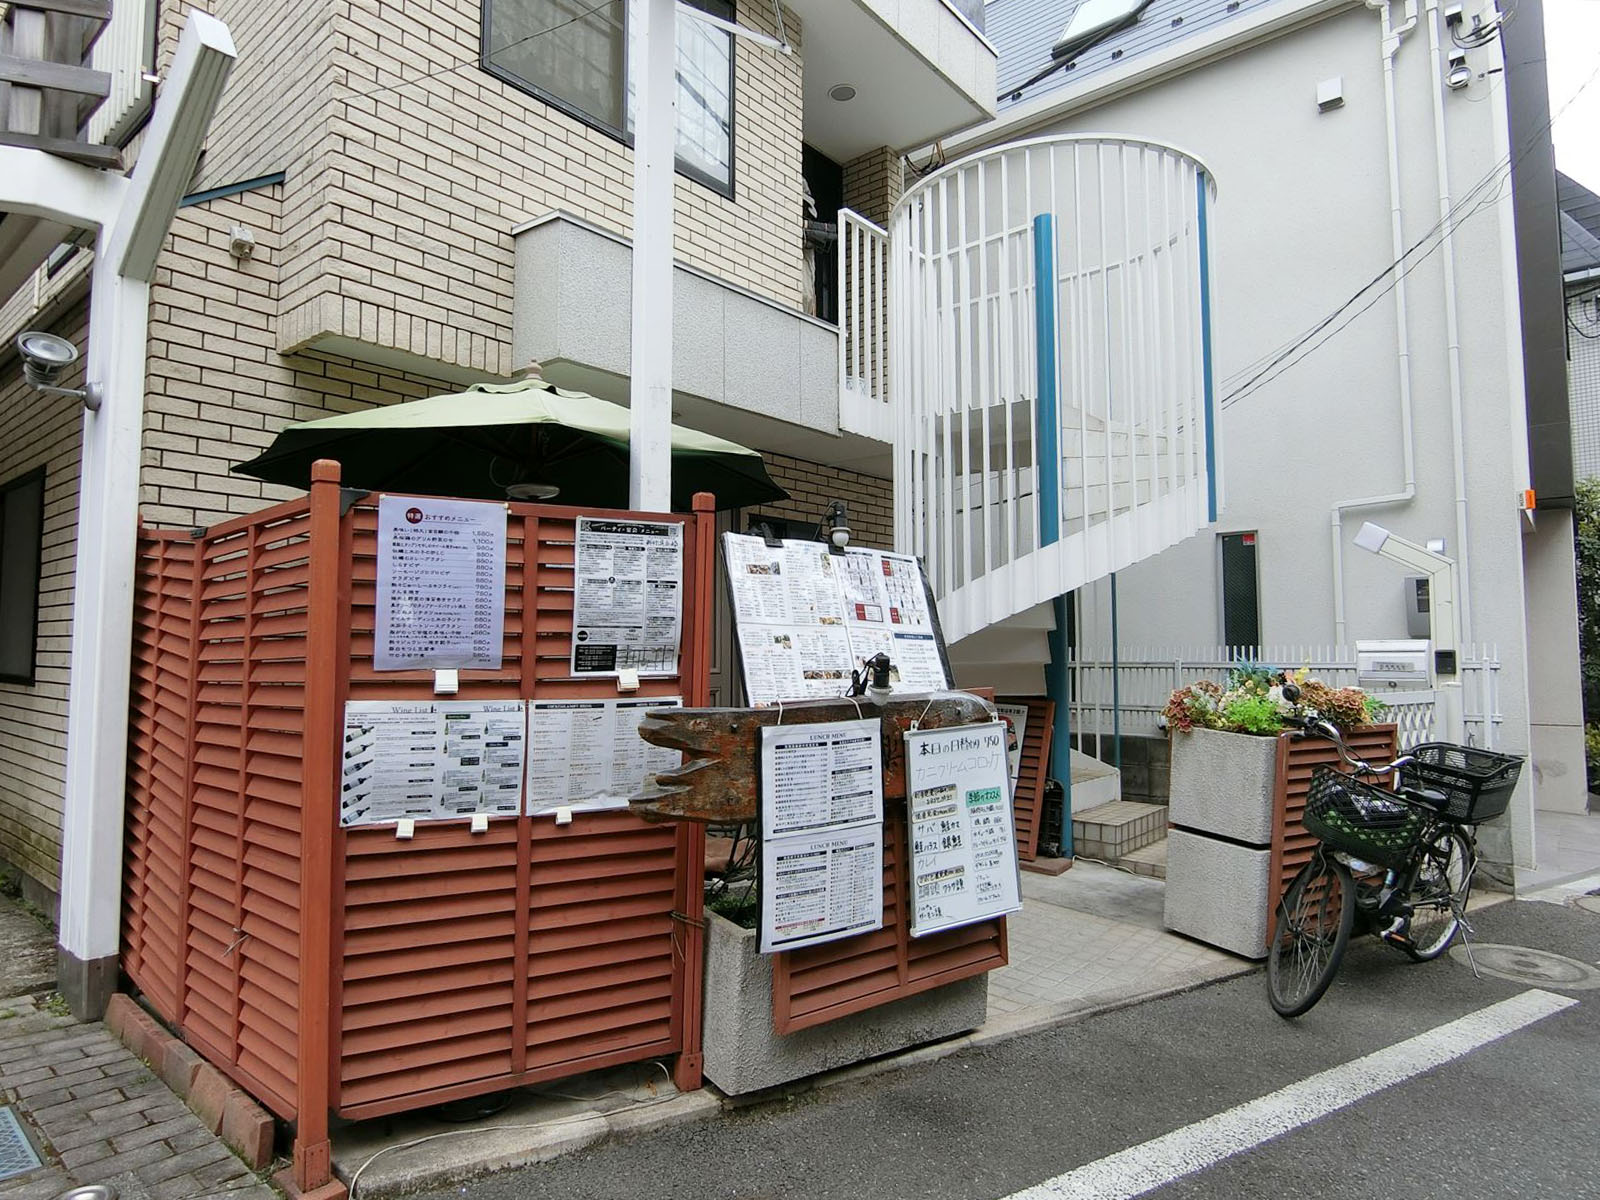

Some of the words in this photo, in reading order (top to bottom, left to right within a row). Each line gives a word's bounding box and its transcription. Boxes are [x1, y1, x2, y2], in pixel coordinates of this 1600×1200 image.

[424, 513, 475, 523] おすすめメニュー
[918, 822, 935, 834] サバ
[914, 840, 938, 854] 鮭ハラス
